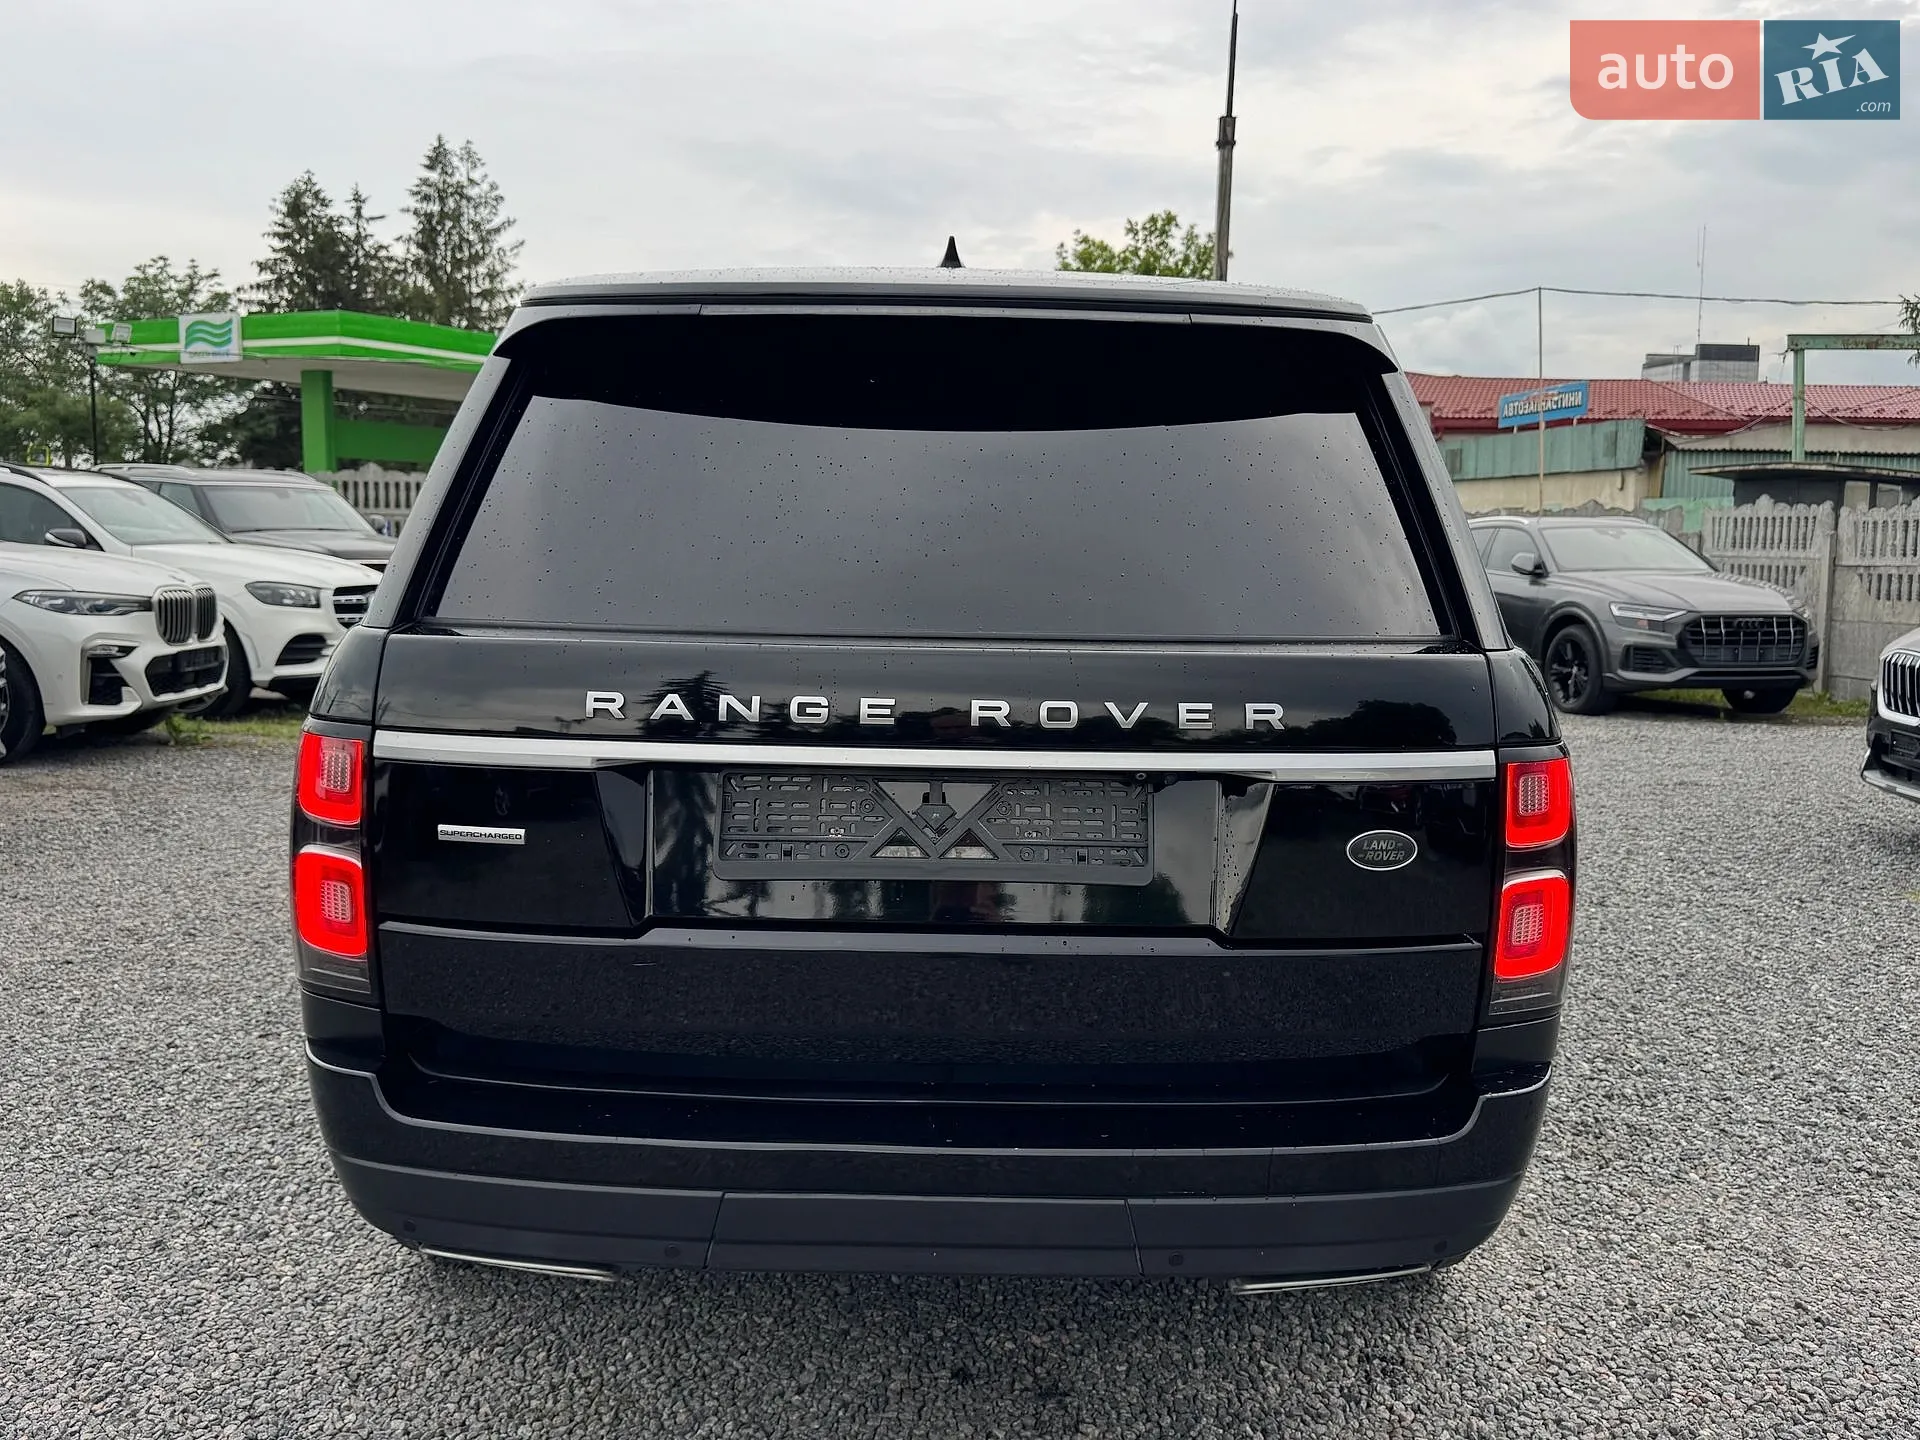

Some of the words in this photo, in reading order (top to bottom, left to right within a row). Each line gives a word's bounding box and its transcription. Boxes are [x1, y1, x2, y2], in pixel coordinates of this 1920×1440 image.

[585, 690, 897, 725] RANGE
[970, 699, 1286, 730] ROVER
[439, 829, 523, 840] SUPERCHARGED
